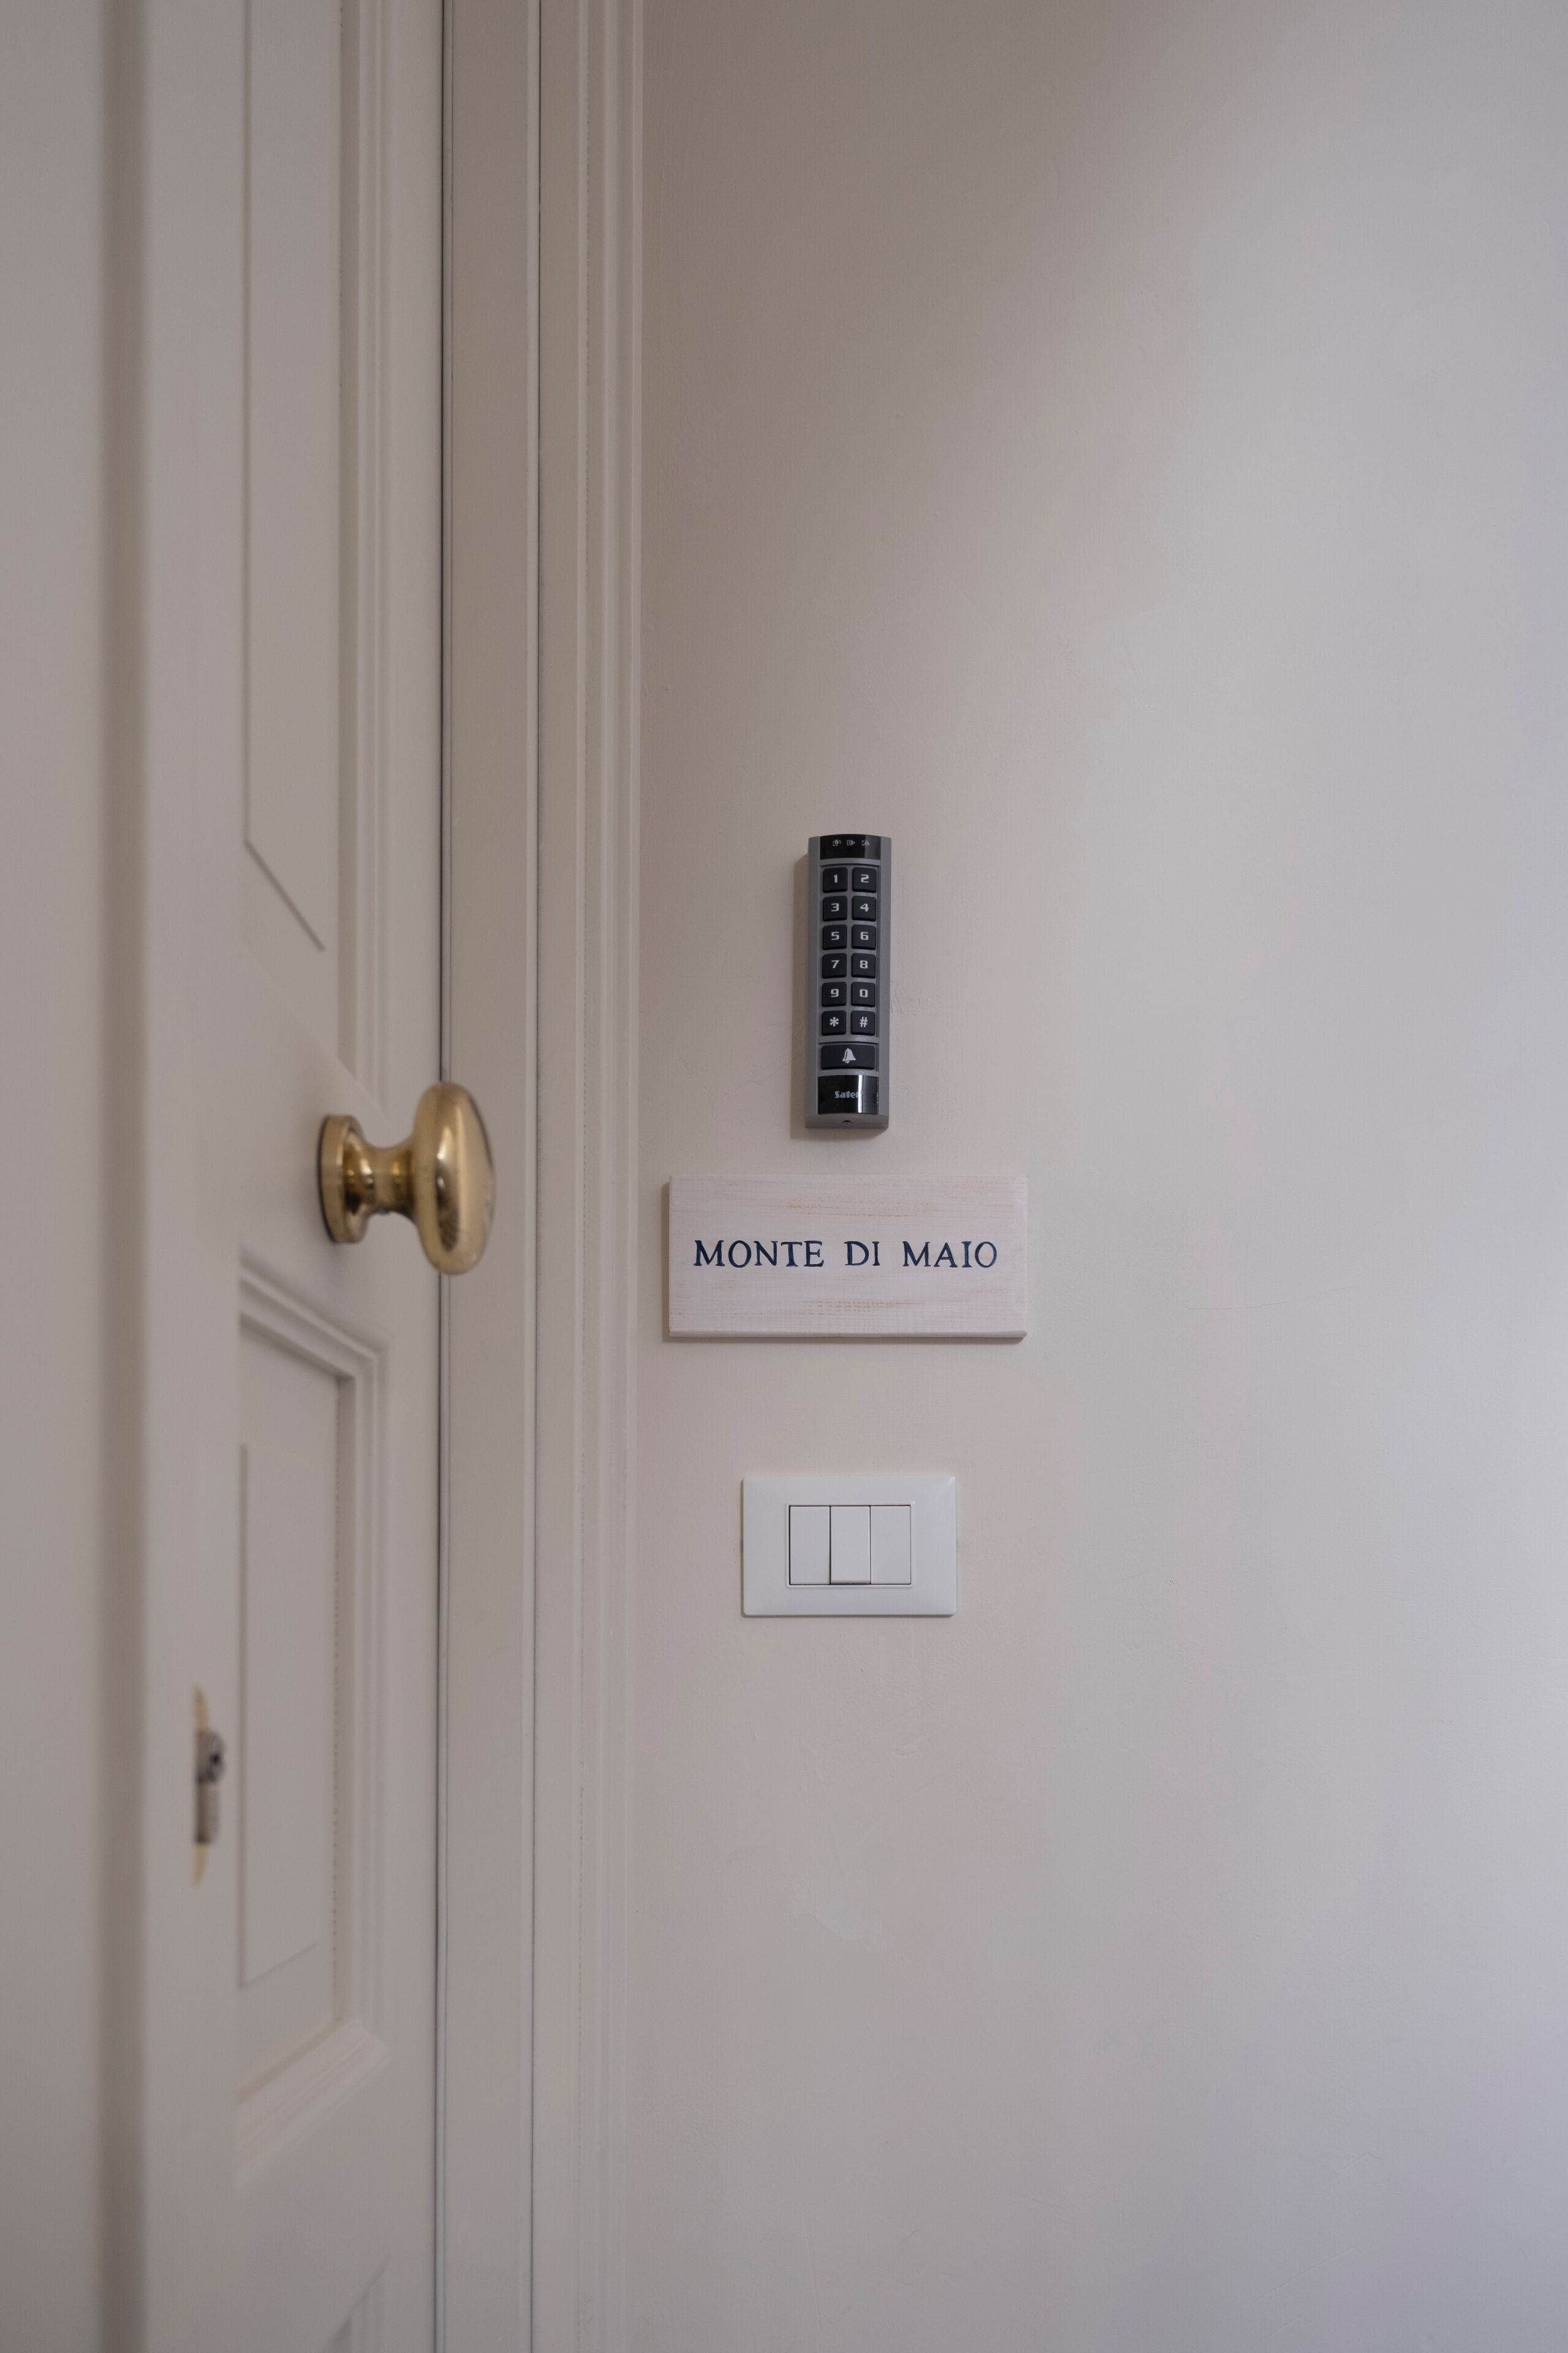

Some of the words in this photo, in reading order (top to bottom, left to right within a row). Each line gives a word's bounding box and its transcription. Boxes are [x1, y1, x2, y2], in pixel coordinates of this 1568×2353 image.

[860, 903, 869, 912] 4
[860, 960, 868, 969] 8
[860, 989, 868, 998] 0
[693, 1240, 824, 1268] MONTE
[844, 1241, 880, 1266] DI
[903, 1241, 997, 1268] MAIO
